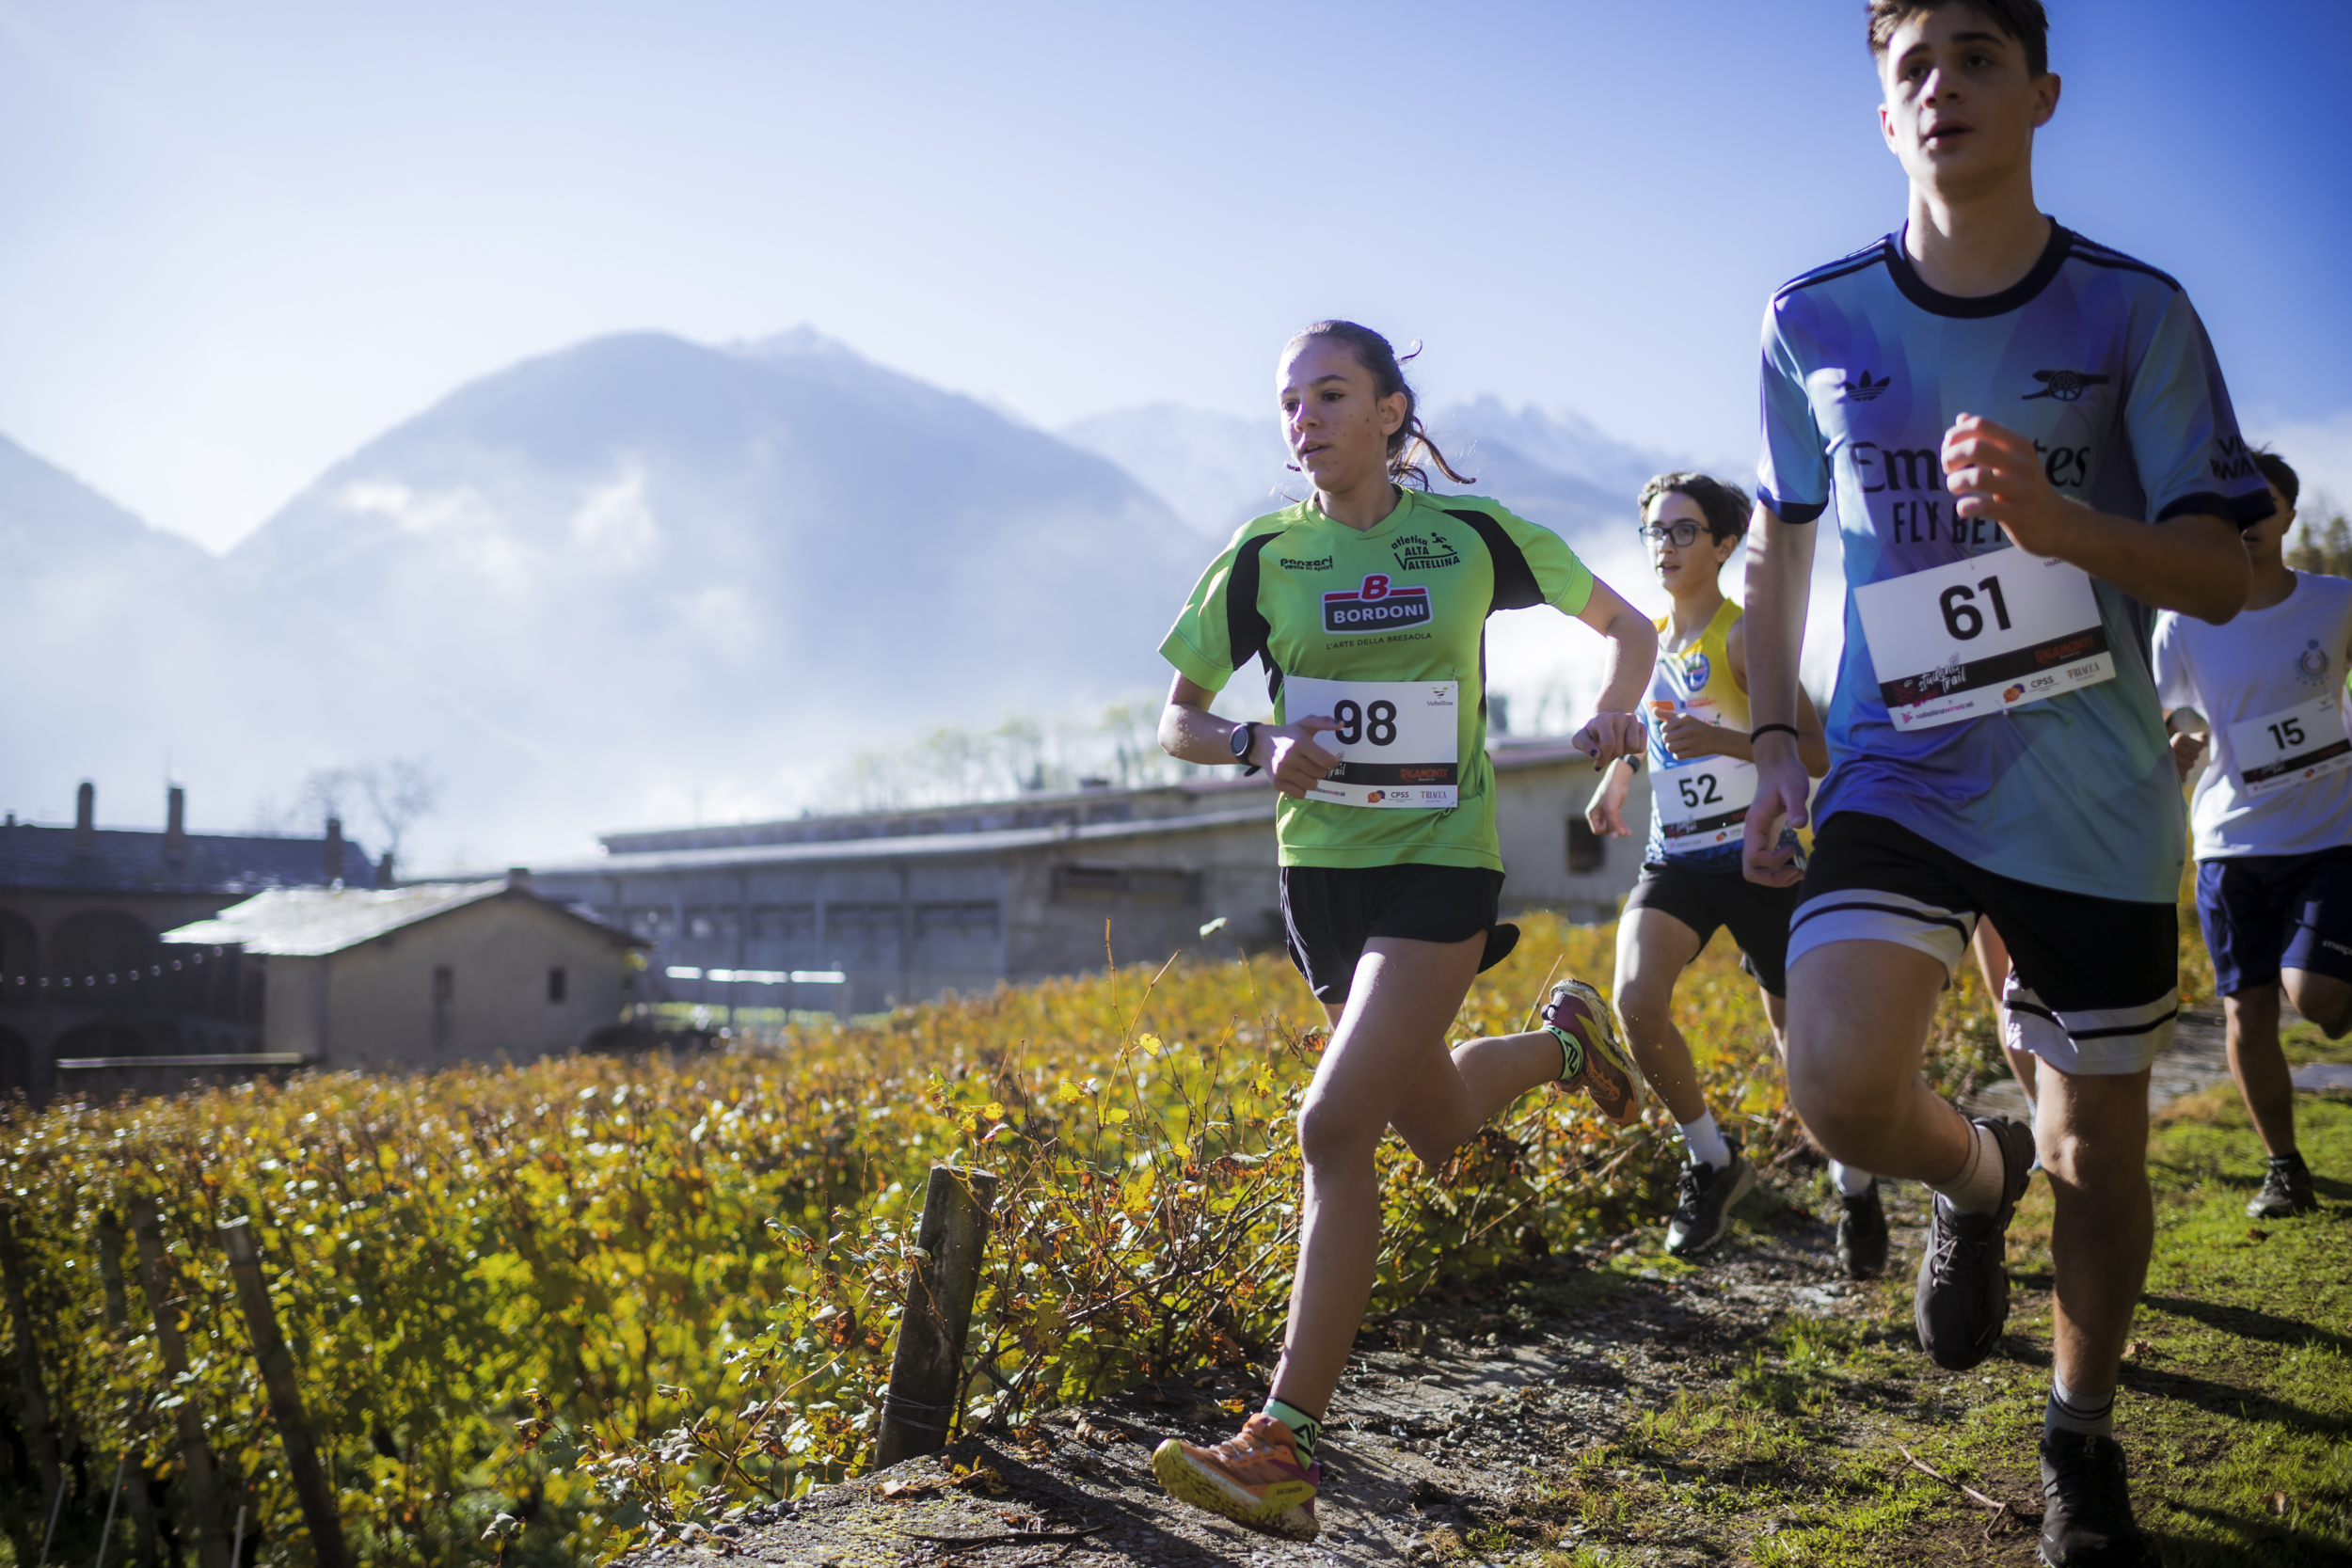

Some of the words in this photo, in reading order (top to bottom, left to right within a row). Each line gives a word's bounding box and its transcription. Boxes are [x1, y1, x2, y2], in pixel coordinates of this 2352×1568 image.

[1850, 438, 2090, 494] Emtes
[1892, 500, 1939, 545] FLY
[1391, 534, 1428, 550] atletica
[1405, 546, 1430, 557] ALTA
[1279, 555, 1333, 567] panzeri
[1393, 552, 1460, 571] VALTELLINA
[1361, 575, 1390, 600] B
[1333, 603, 1424, 625] BORDONI
[1939, 575, 2011, 641] 61
[1326, 640, 1355, 651] L'ARTE
[1358, 637, 1385, 646] DELLA
[1387, 632, 1432, 643] BRESAOLA
[2034, 636, 2093, 664] RIGAMONTI
[2065, 662, 2100, 679] TRIACCA
[2030, 675, 2054, 689] CPSS
[1334, 699, 1397, 747] 98
[2267, 717, 2306, 751] 15
[1400, 768, 1447, 783] RIGAMONTI
[1420, 790, 1448, 800] TRIACCA
[1678, 773, 1724, 808] 52
[1276, 1486, 1303, 1496] SALOMON
